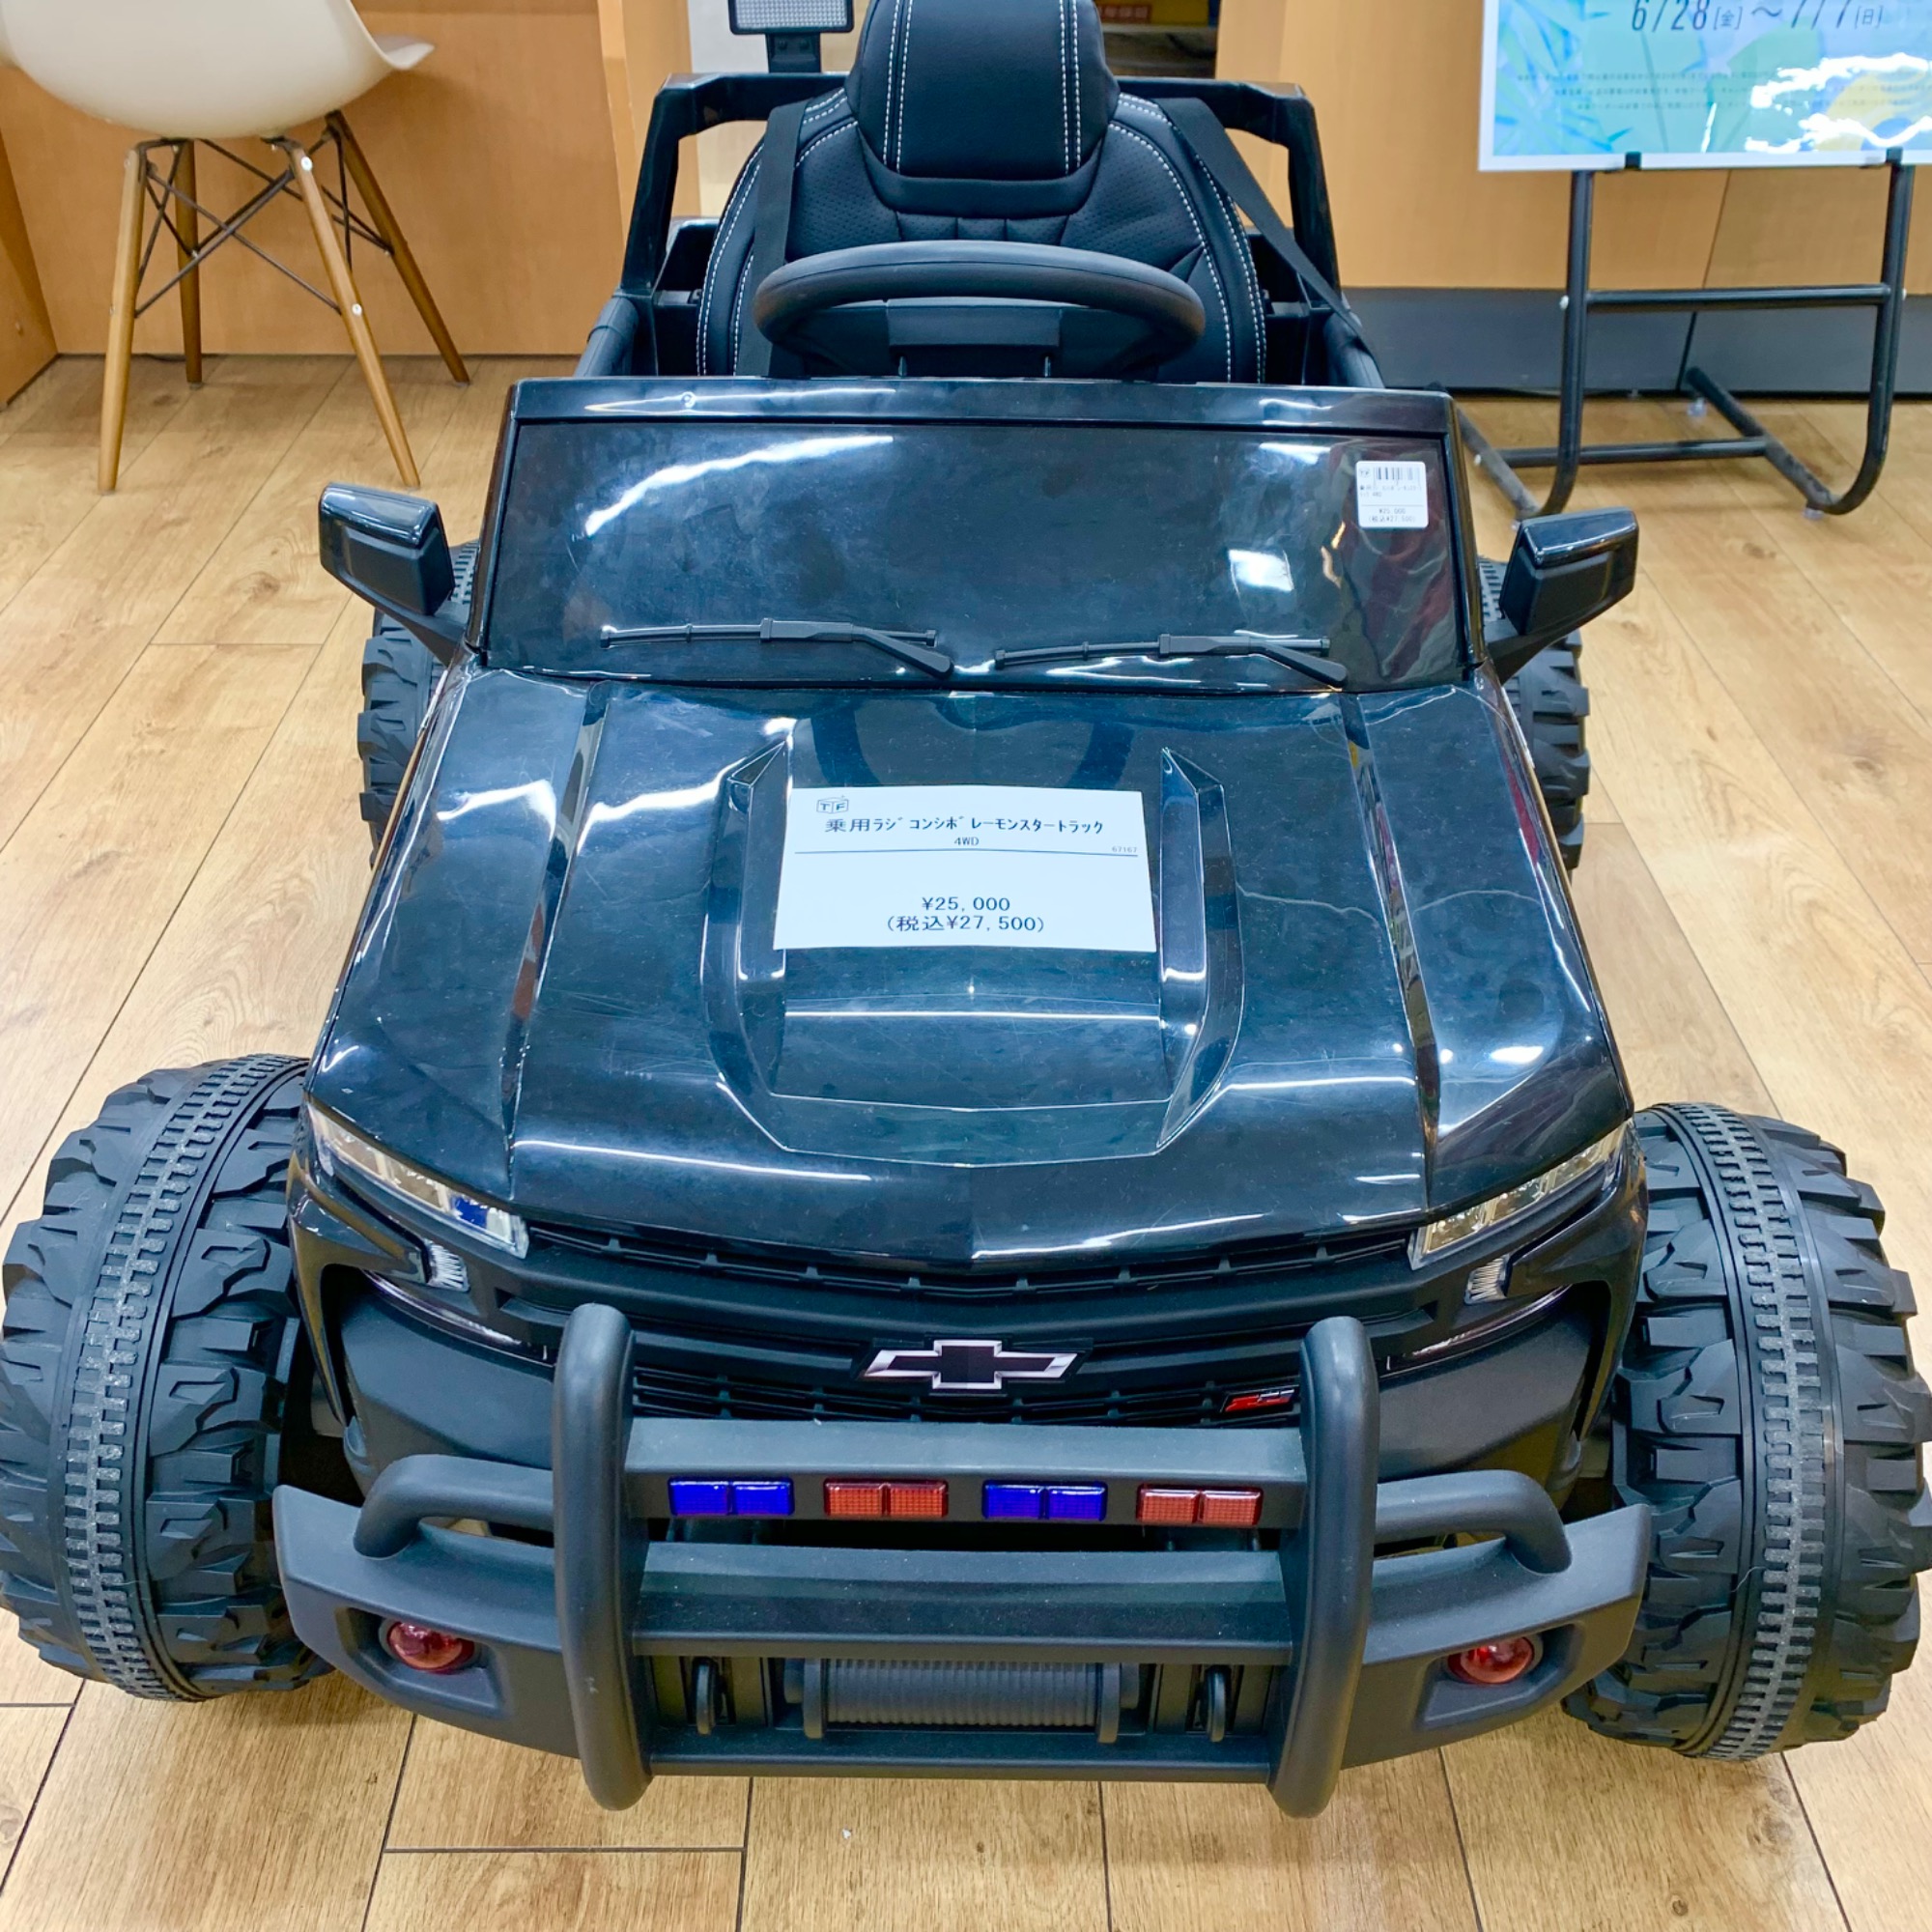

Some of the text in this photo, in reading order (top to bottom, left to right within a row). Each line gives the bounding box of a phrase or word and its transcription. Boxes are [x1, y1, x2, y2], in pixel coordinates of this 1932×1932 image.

[953, 836, 980, 846] 4WD
[922, 896, 1010, 912] ¥25,000
[887, 915, 1045, 932] (税込¥27,500)
